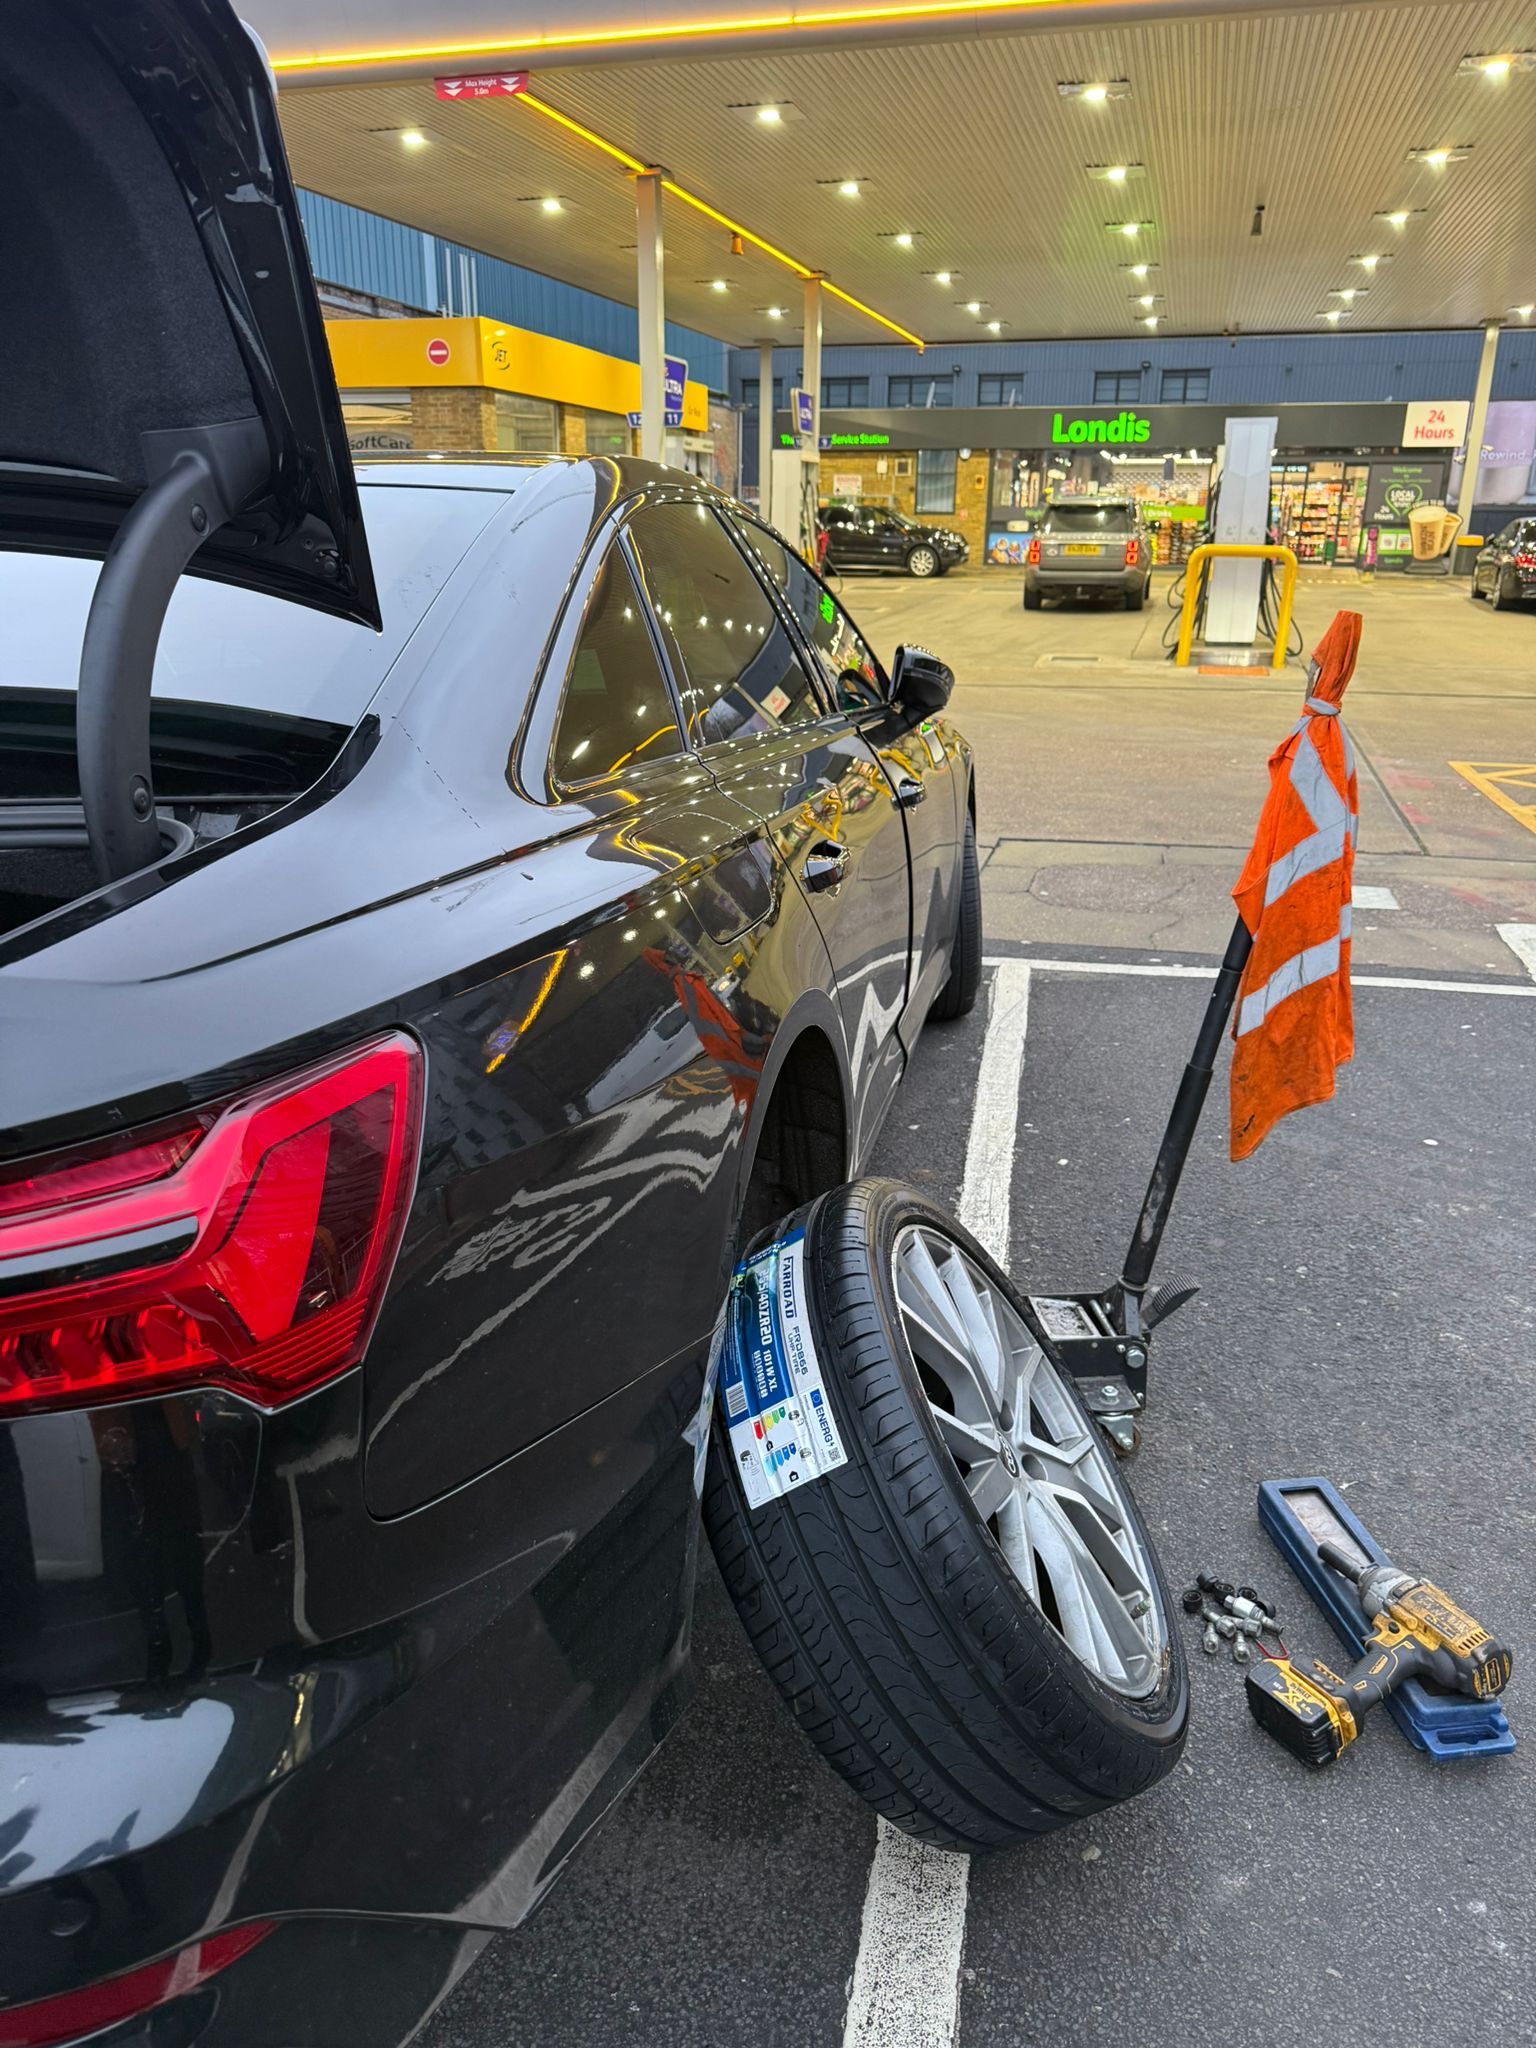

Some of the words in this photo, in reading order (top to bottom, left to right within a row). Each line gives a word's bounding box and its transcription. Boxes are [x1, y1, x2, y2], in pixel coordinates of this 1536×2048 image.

[478, 79, 498, 88] Height
[494, 349, 508, 363] JET
[667, 413, 678, 425] 11
[1427, 409, 1446, 424] 24
[1052, 412, 1151, 443] Londis
[1414, 426, 1455, 439] Hours
[1391, 490, 1415, 499] LOCAL
[783, 1255, 798, 1319] FARROAD
[792, 1325, 809, 1376] FRD866
[791, 1354, 801, 1375] TIRE
[815, 1406, 835, 1444] ENERG
